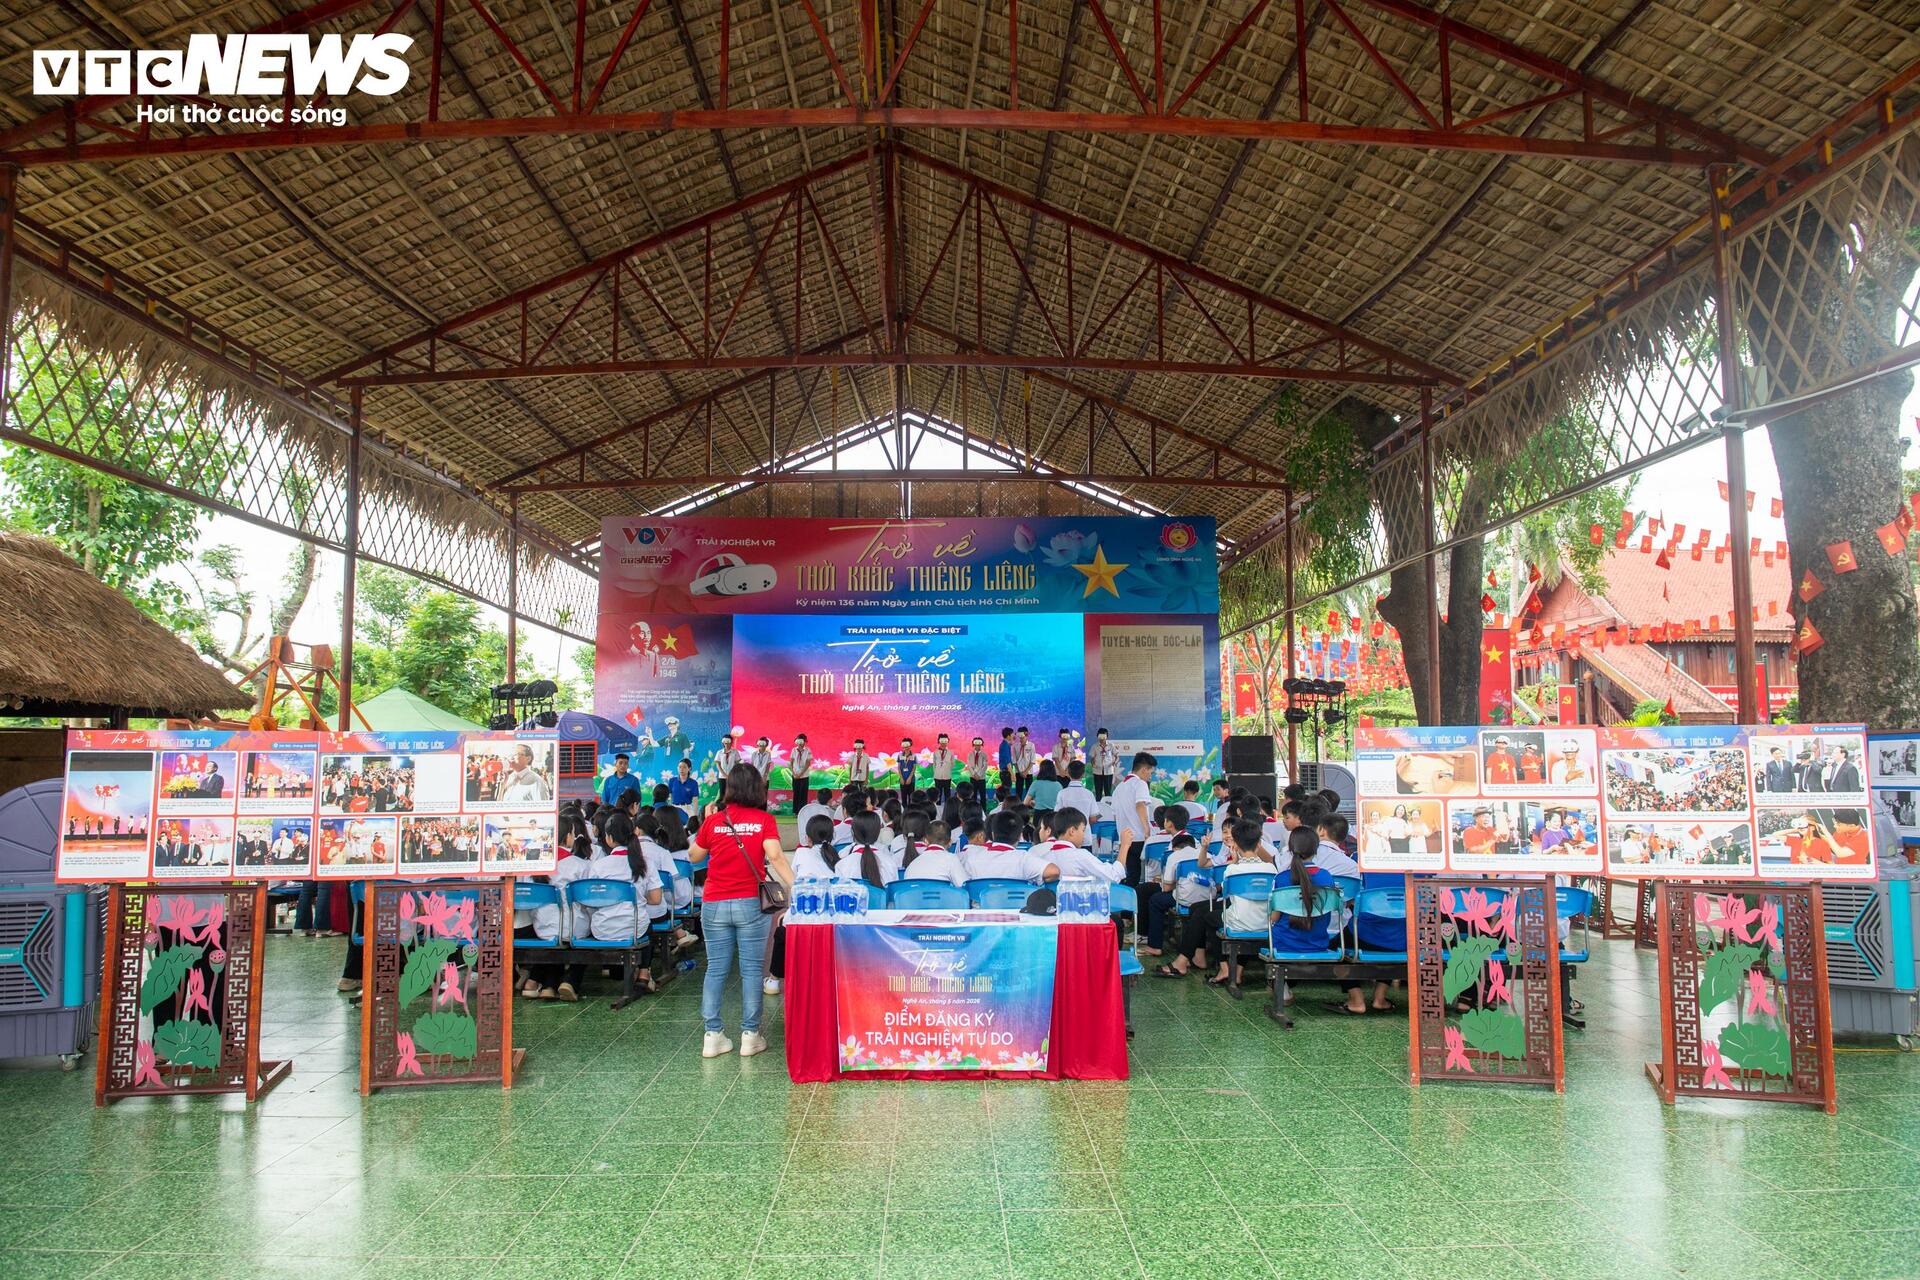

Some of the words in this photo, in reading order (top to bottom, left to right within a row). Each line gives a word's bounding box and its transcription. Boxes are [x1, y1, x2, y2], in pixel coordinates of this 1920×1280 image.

[622, 527, 673, 545] VOV
[696, 537, 718, 546] TRẢI
[720, 537, 760, 547] NGHIỆM
[762, 539, 776, 547] VR
[828, 521, 947, 563] Trở
[933, 529, 977, 559] về
[795, 559, 838, 592] THỜI
[847, 556, 895, 592] KHẮC
[906, 560, 973, 592] THIÊNG
[983, 560, 1037, 591] LIÊNG
[810, 598, 837, 608] niệm
[839, 598, 855, 607] 136
[857, 598, 880, 607] năm
[882, 599, 908, 609] Ngày
[911, 598, 932, 607] sinh
[934, 597, 955, 606] Chủ
[957, 597, 977, 608] tịch
[978, 597, 993, 606] Hồ
[995, 597, 1013, 605] Chí
[1014, 596, 1040, 605] Minh
[846, 626, 868, 634] TRẢI
[869, 627, 904, 635] NGHIỆM
[920, 627, 939, 635] ĐẶC
[941, 627, 961, 635] BIỆT
[661, 657, 676, 666] 2/9
[826, 638, 930, 672] Trở
[917, 645, 956, 668] về
[659, 669, 677, 678] 1945
[798, 669, 835, 694] THỜI
[844, 666, 884, 694] KHẮC
[894, 669, 950, 694] THIÊNG
[960, 668, 1005, 694] LIÊNG
[841, 703, 866, 712] Nghệ
[883, 703, 910, 712] tháng
[902, 948, 955, 975] Trở
[947, 953, 967, 972] về
[884, 1005, 921, 1026] ĐIỂM
[925, 1009, 971, 1027] ĐĂNG
[974, 1009, 995, 1027] KÝ
[865, 1027, 899, 1046] TRẢI
[903, 1028, 964, 1049] NGHIỆM
[967, 1030, 988, 1049] TỰ
[991, 1032, 1014, 1046] DO
